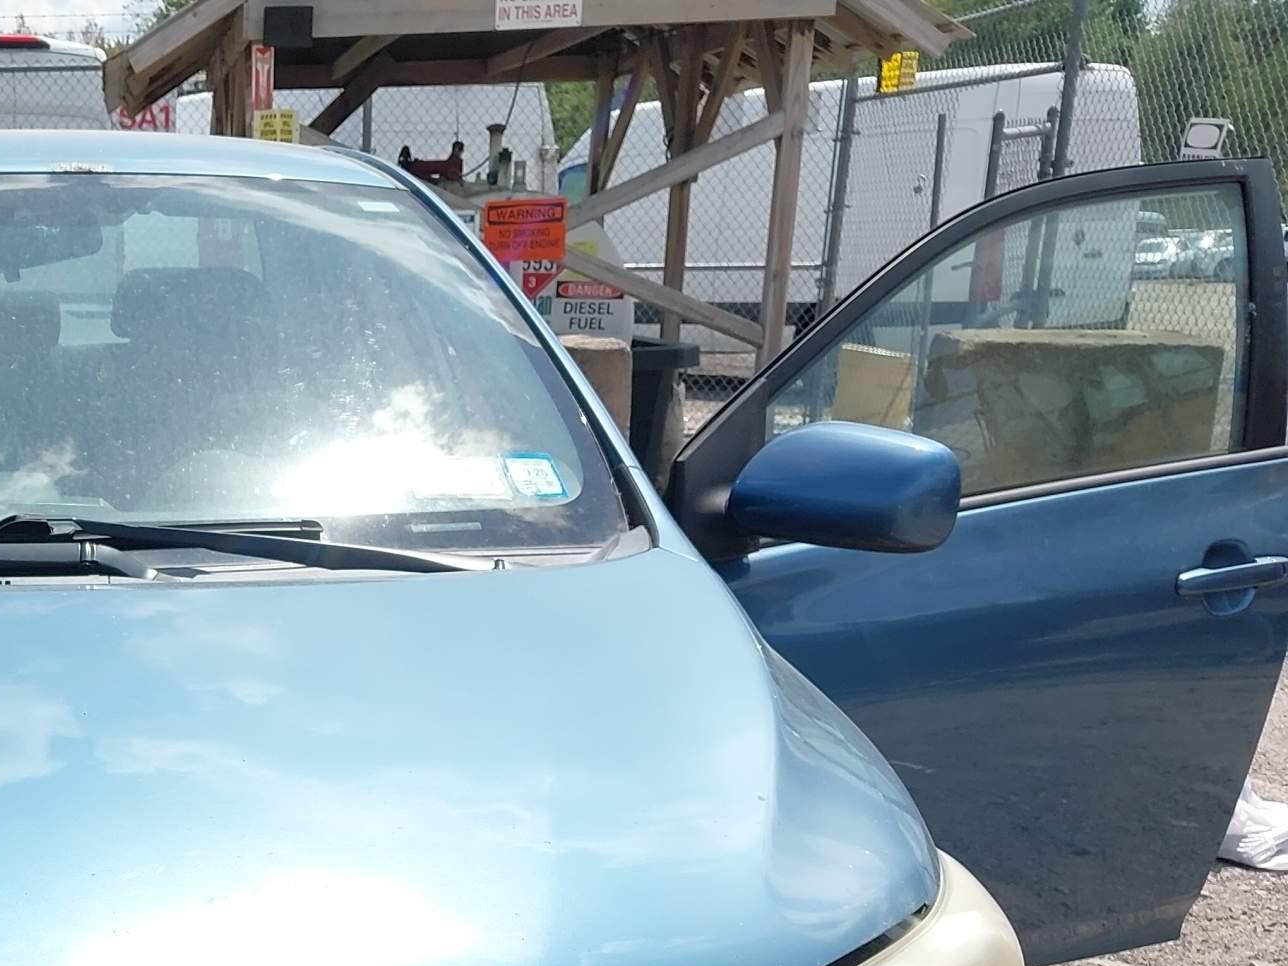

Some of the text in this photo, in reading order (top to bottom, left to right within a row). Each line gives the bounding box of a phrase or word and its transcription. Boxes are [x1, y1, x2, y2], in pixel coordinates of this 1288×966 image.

[498, 4, 578, 20] IN THIS AREA
[497, 207, 556, 220] WARNING
[498, 227, 550, 239] NO SMOKING
[530, 238, 561, 249] ENGINE
[527, 275, 537, 289] 3
[563, 301, 614, 316] DIESEL
[568, 317, 606, 331] FUEL
